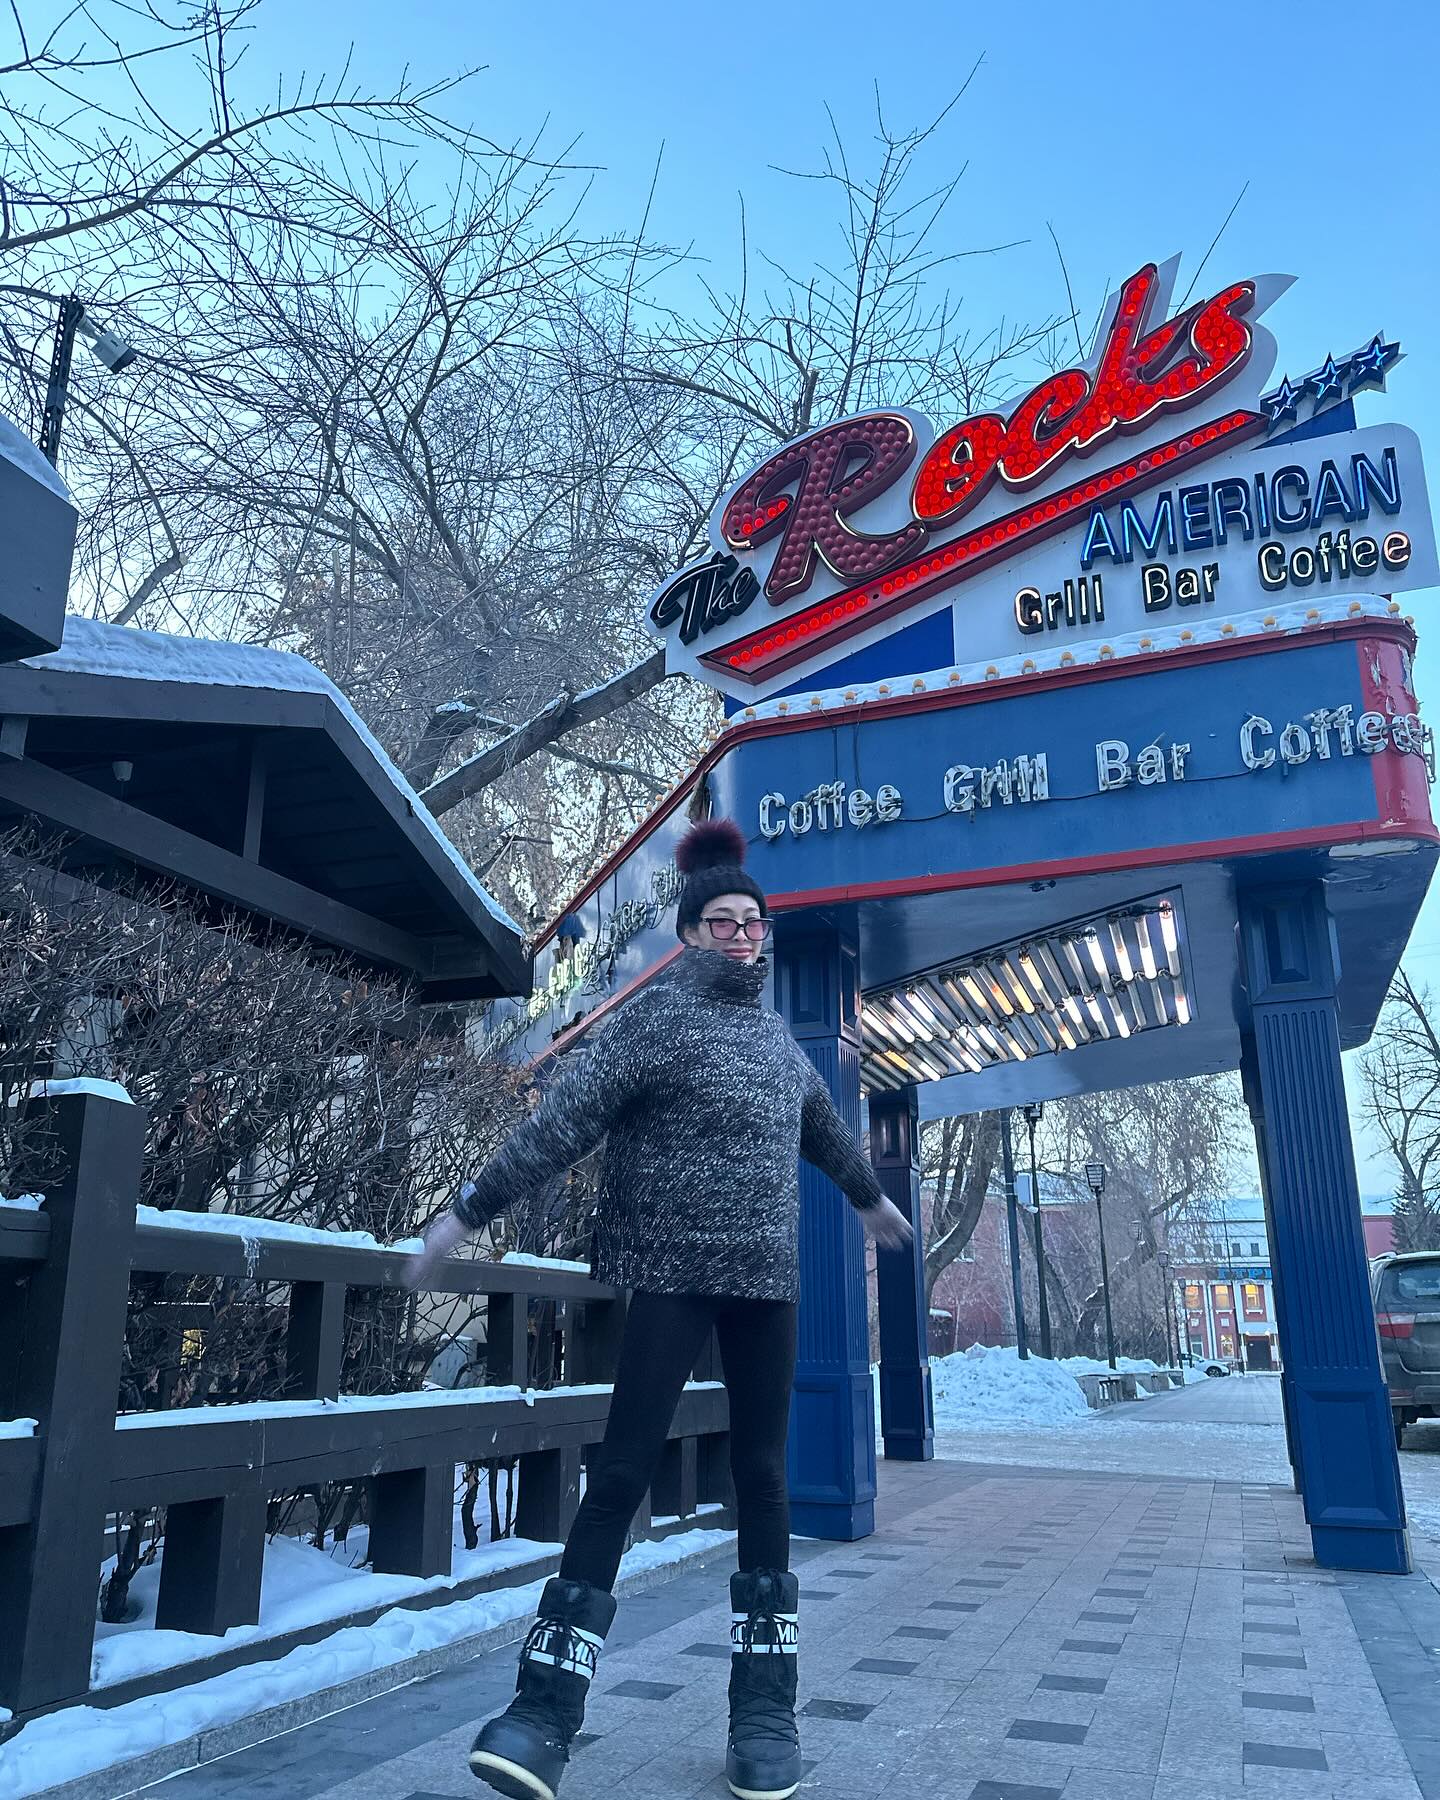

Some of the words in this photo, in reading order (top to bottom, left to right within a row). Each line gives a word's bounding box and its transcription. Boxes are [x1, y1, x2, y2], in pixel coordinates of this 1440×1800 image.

[1080, 447, 1402, 570] AMERICAN
[650, 551, 761, 646] The
[1014, 574, 1105, 635] Grill
[1141, 562, 1219, 613] Bar
[1257, 528, 1412, 591] Coffee
[758, 781, 902, 839] Coffee
[943, 752, 1049, 814] Grill
[1096, 739, 1190, 792] Bar
[1239, 704, 1426, 770] Coffee
